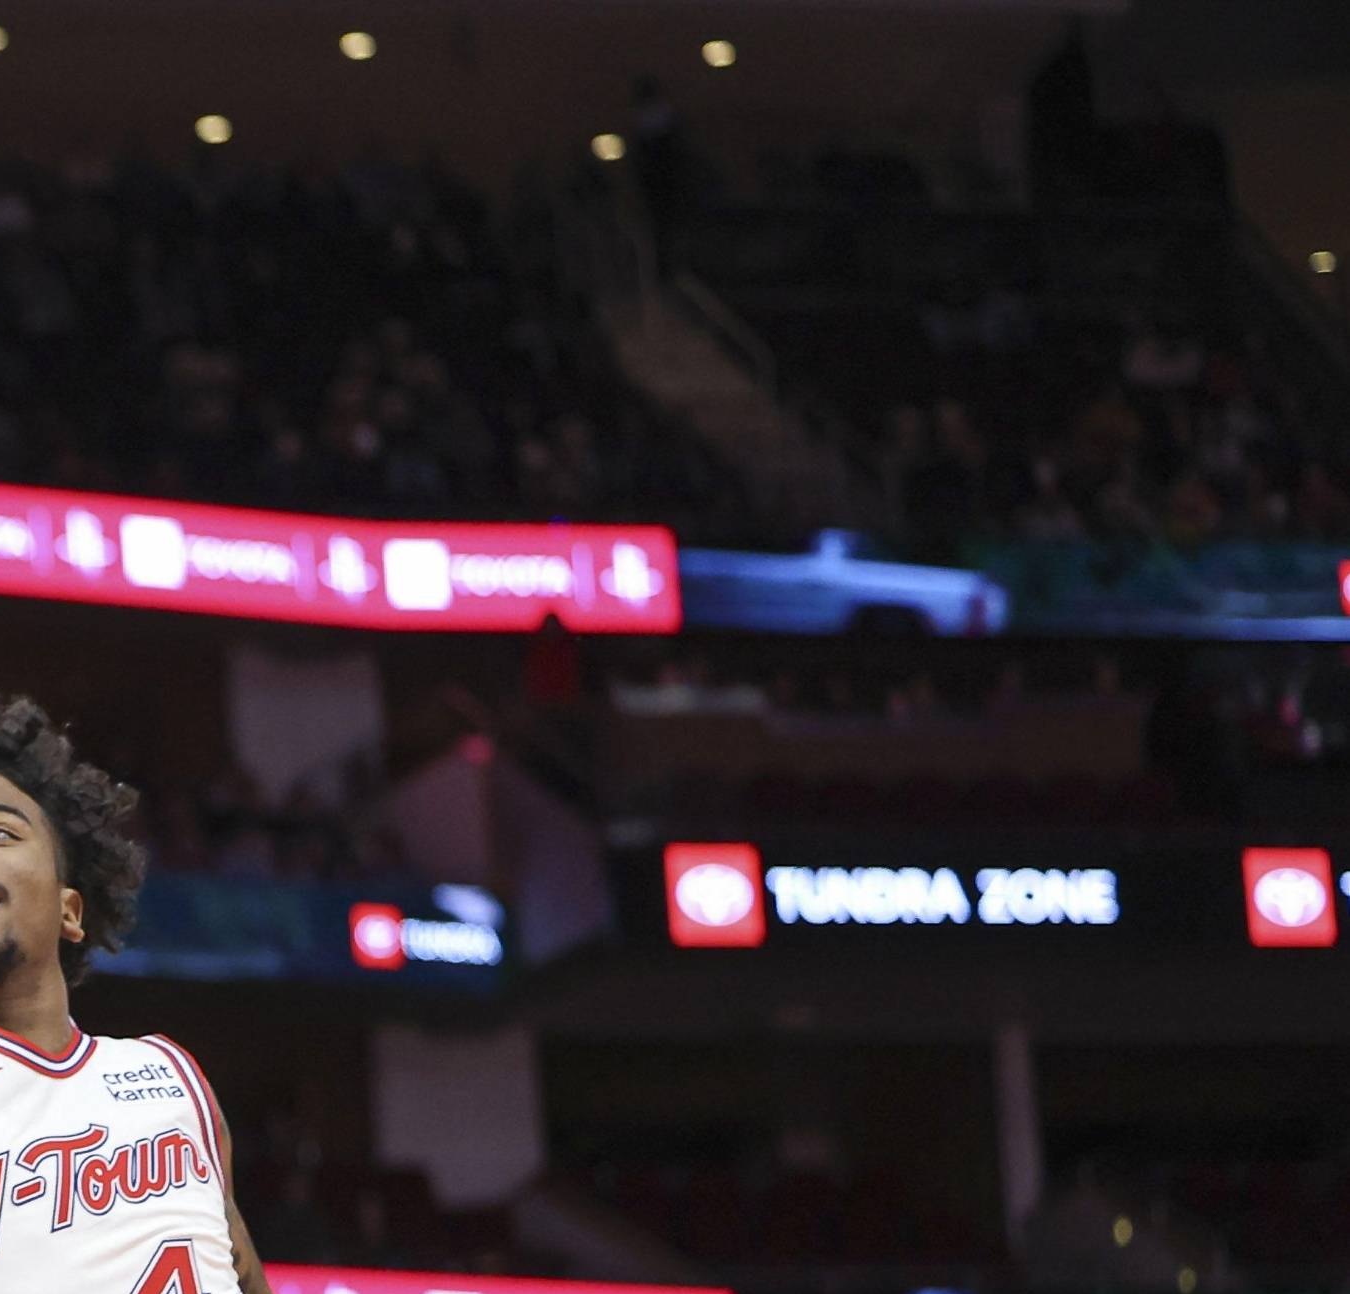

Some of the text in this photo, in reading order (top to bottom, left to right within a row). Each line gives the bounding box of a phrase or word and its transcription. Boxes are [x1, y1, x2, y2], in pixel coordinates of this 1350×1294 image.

[768, 867, 1119, 924] TUNDRA ZONE
[102, 1064, 174, 1085] credit
[105, 1085, 185, 1102] karma
